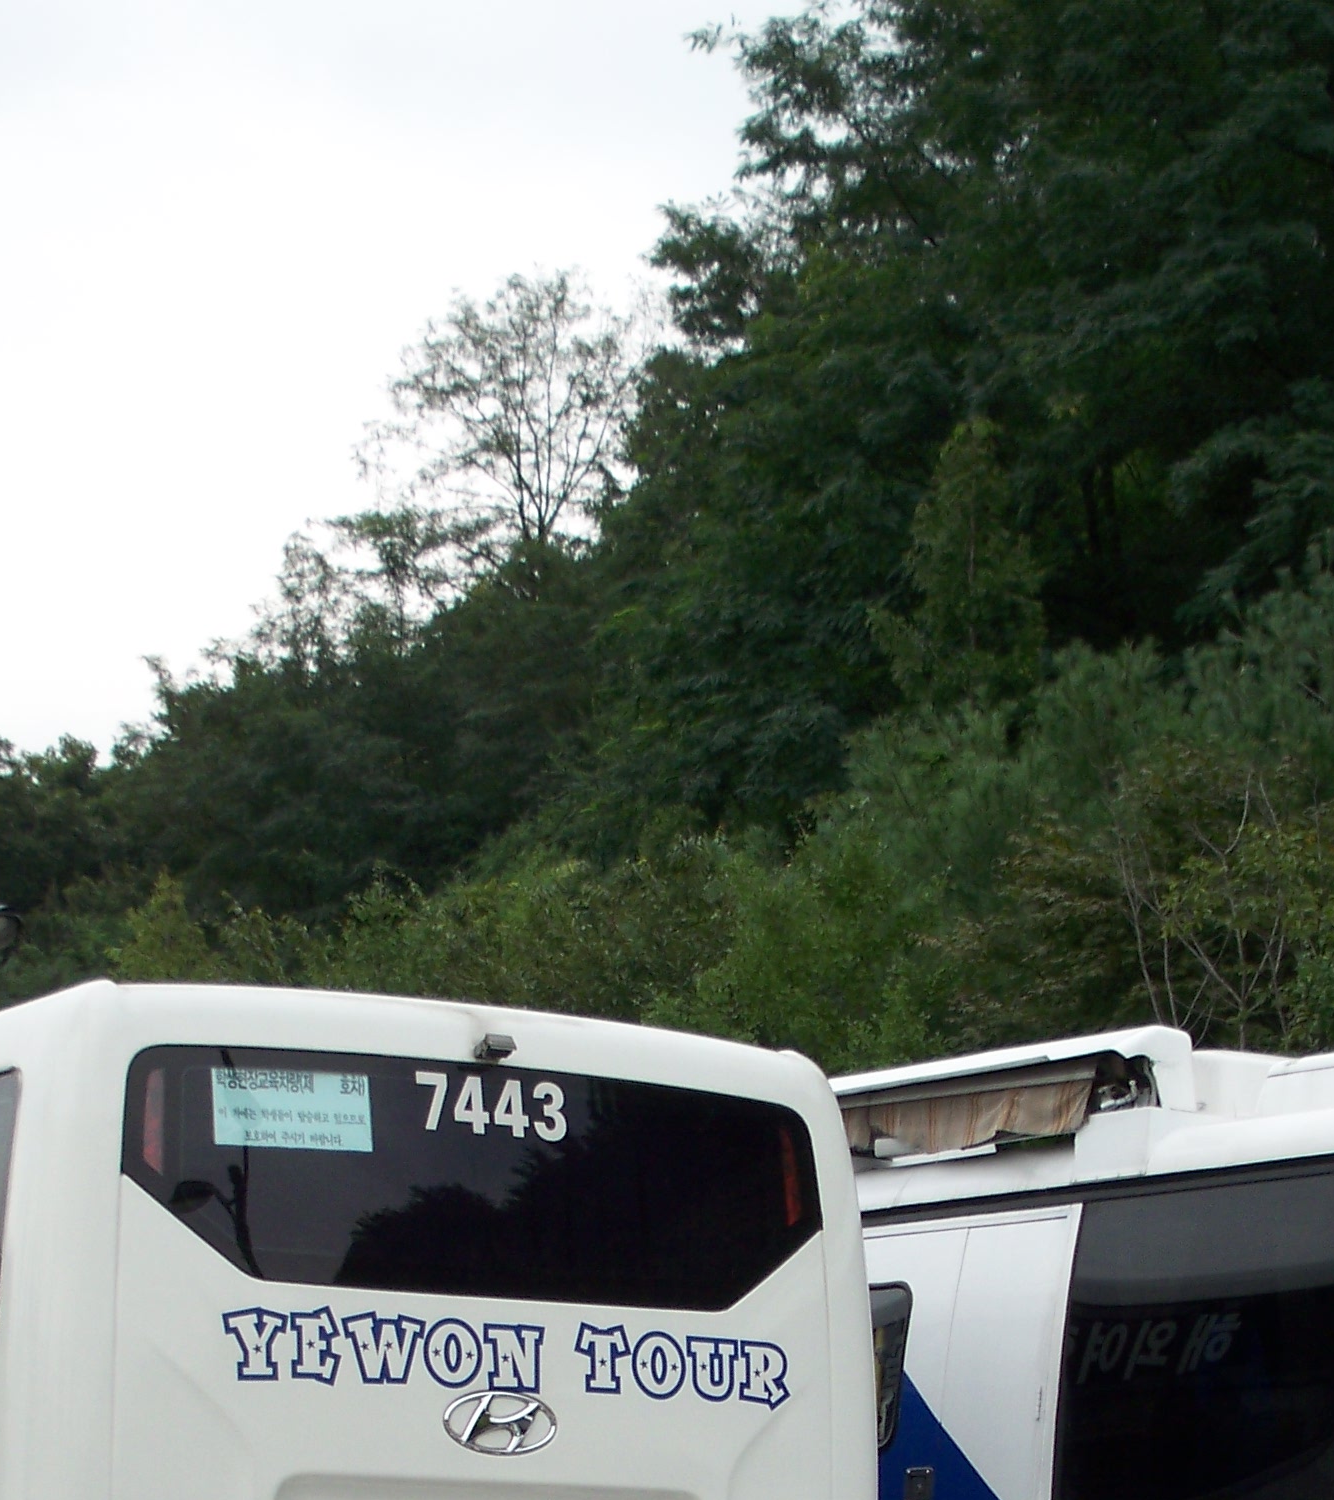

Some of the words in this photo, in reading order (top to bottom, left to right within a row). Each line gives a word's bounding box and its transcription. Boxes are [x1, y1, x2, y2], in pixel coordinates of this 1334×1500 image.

[415, 1070, 568, 1142] 7443
[222, 1306, 545, 1394] YEWON
[574, 1322, 790, 1411] TOUR
